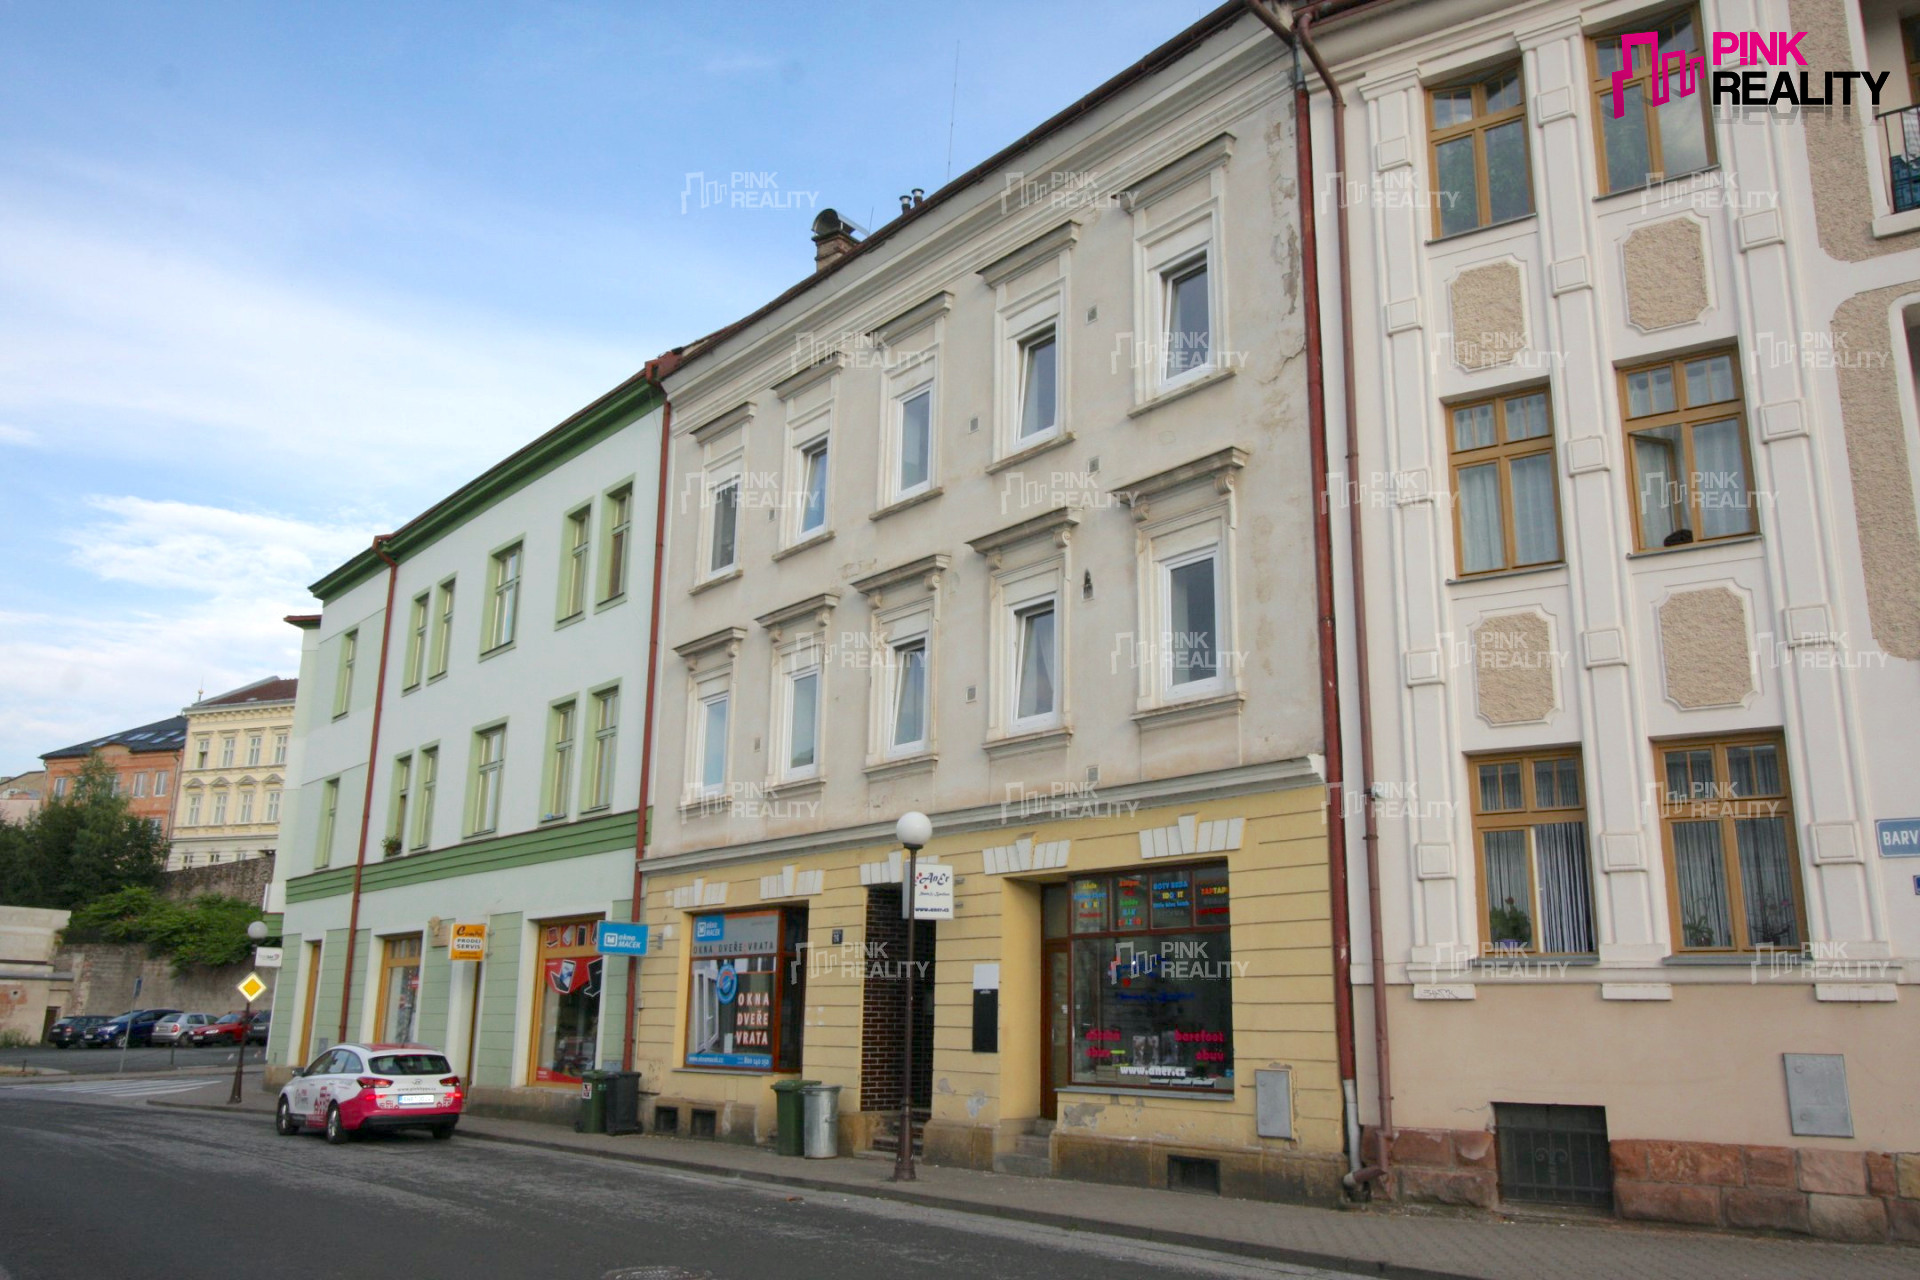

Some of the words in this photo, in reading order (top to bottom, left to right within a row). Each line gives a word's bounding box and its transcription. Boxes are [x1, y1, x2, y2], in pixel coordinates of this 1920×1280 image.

[693, 945, 713, 953] OKNA
[748, 941, 773, 951] VRATA
[738, 993, 769, 1006] OKNA
[737, 1010, 769, 1026] DVEŘE
[736, 1031, 768, 1045] VRATA
